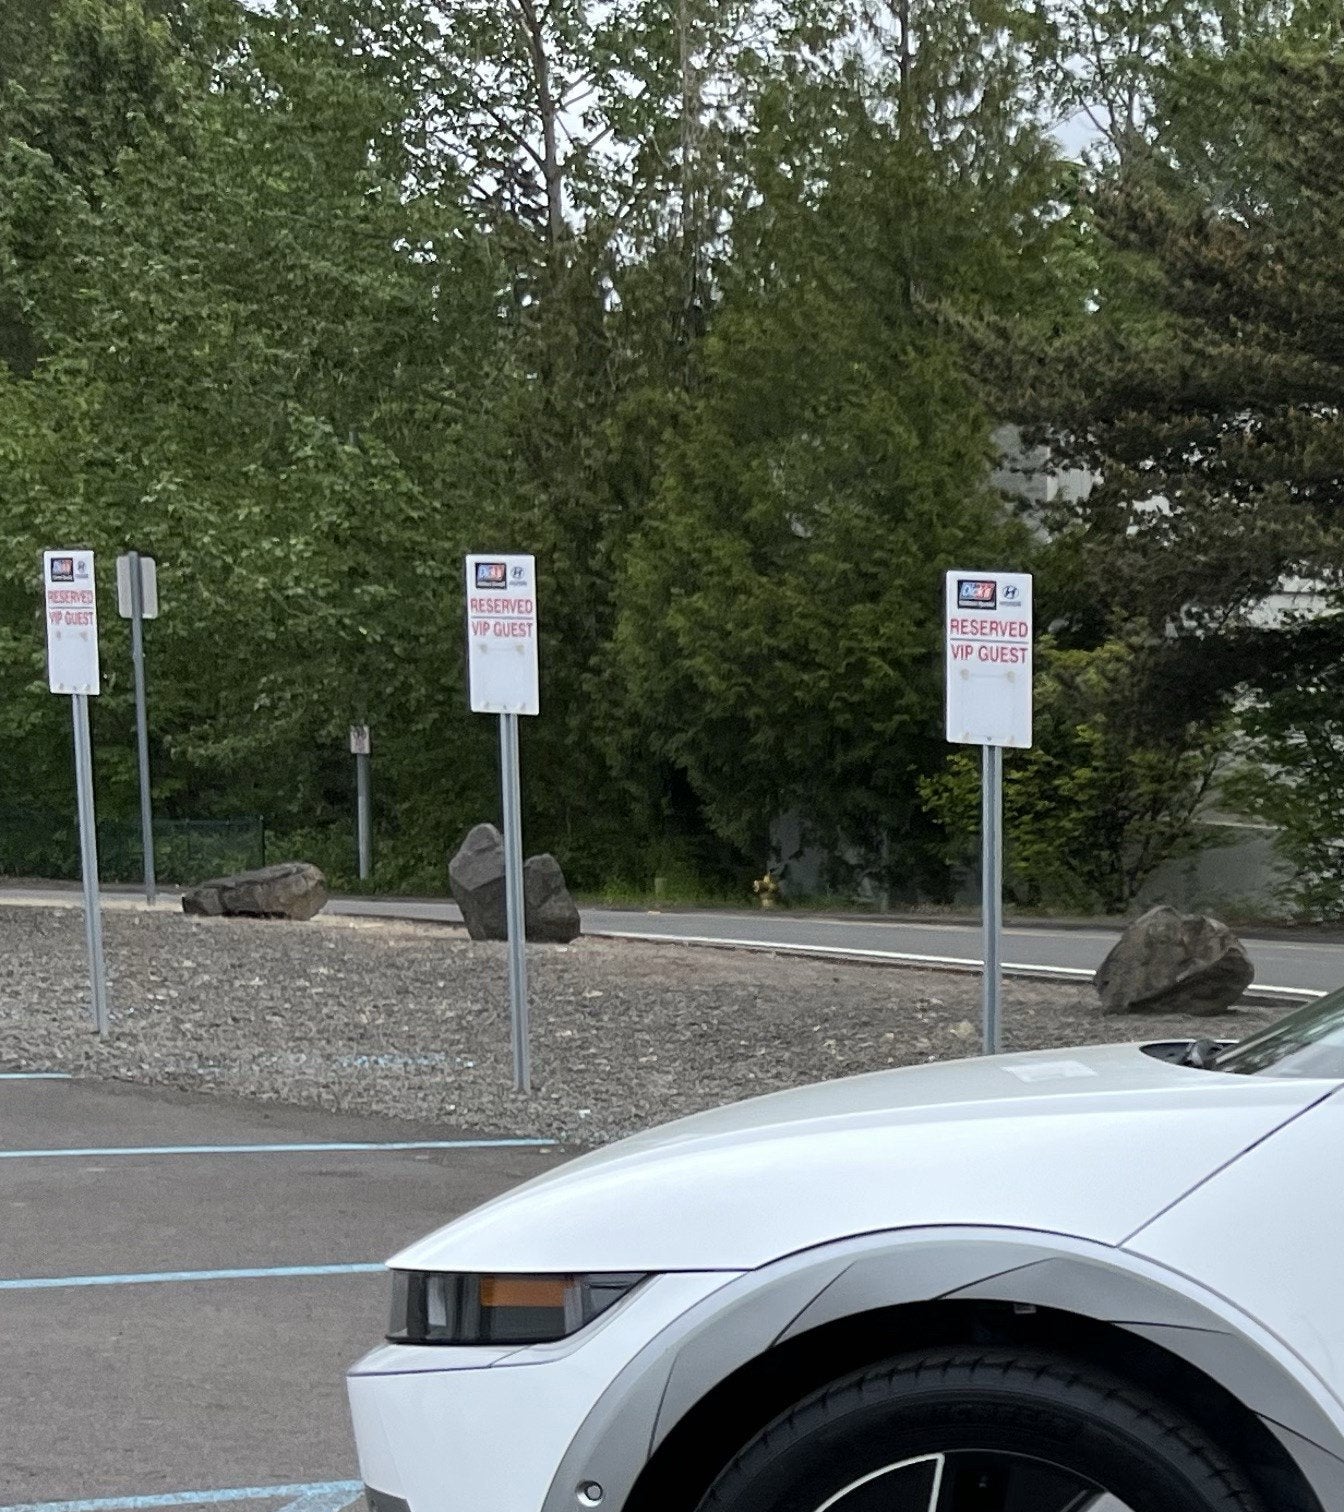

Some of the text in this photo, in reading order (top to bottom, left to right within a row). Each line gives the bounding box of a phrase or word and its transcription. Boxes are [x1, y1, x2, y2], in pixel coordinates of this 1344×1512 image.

[470, 598, 533, 614] RESERVED
[472, 621, 533, 638] VIP GUEST
[950, 619, 1028, 638] RESERVED
[951, 644, 1028, 663] VIP GUEST
